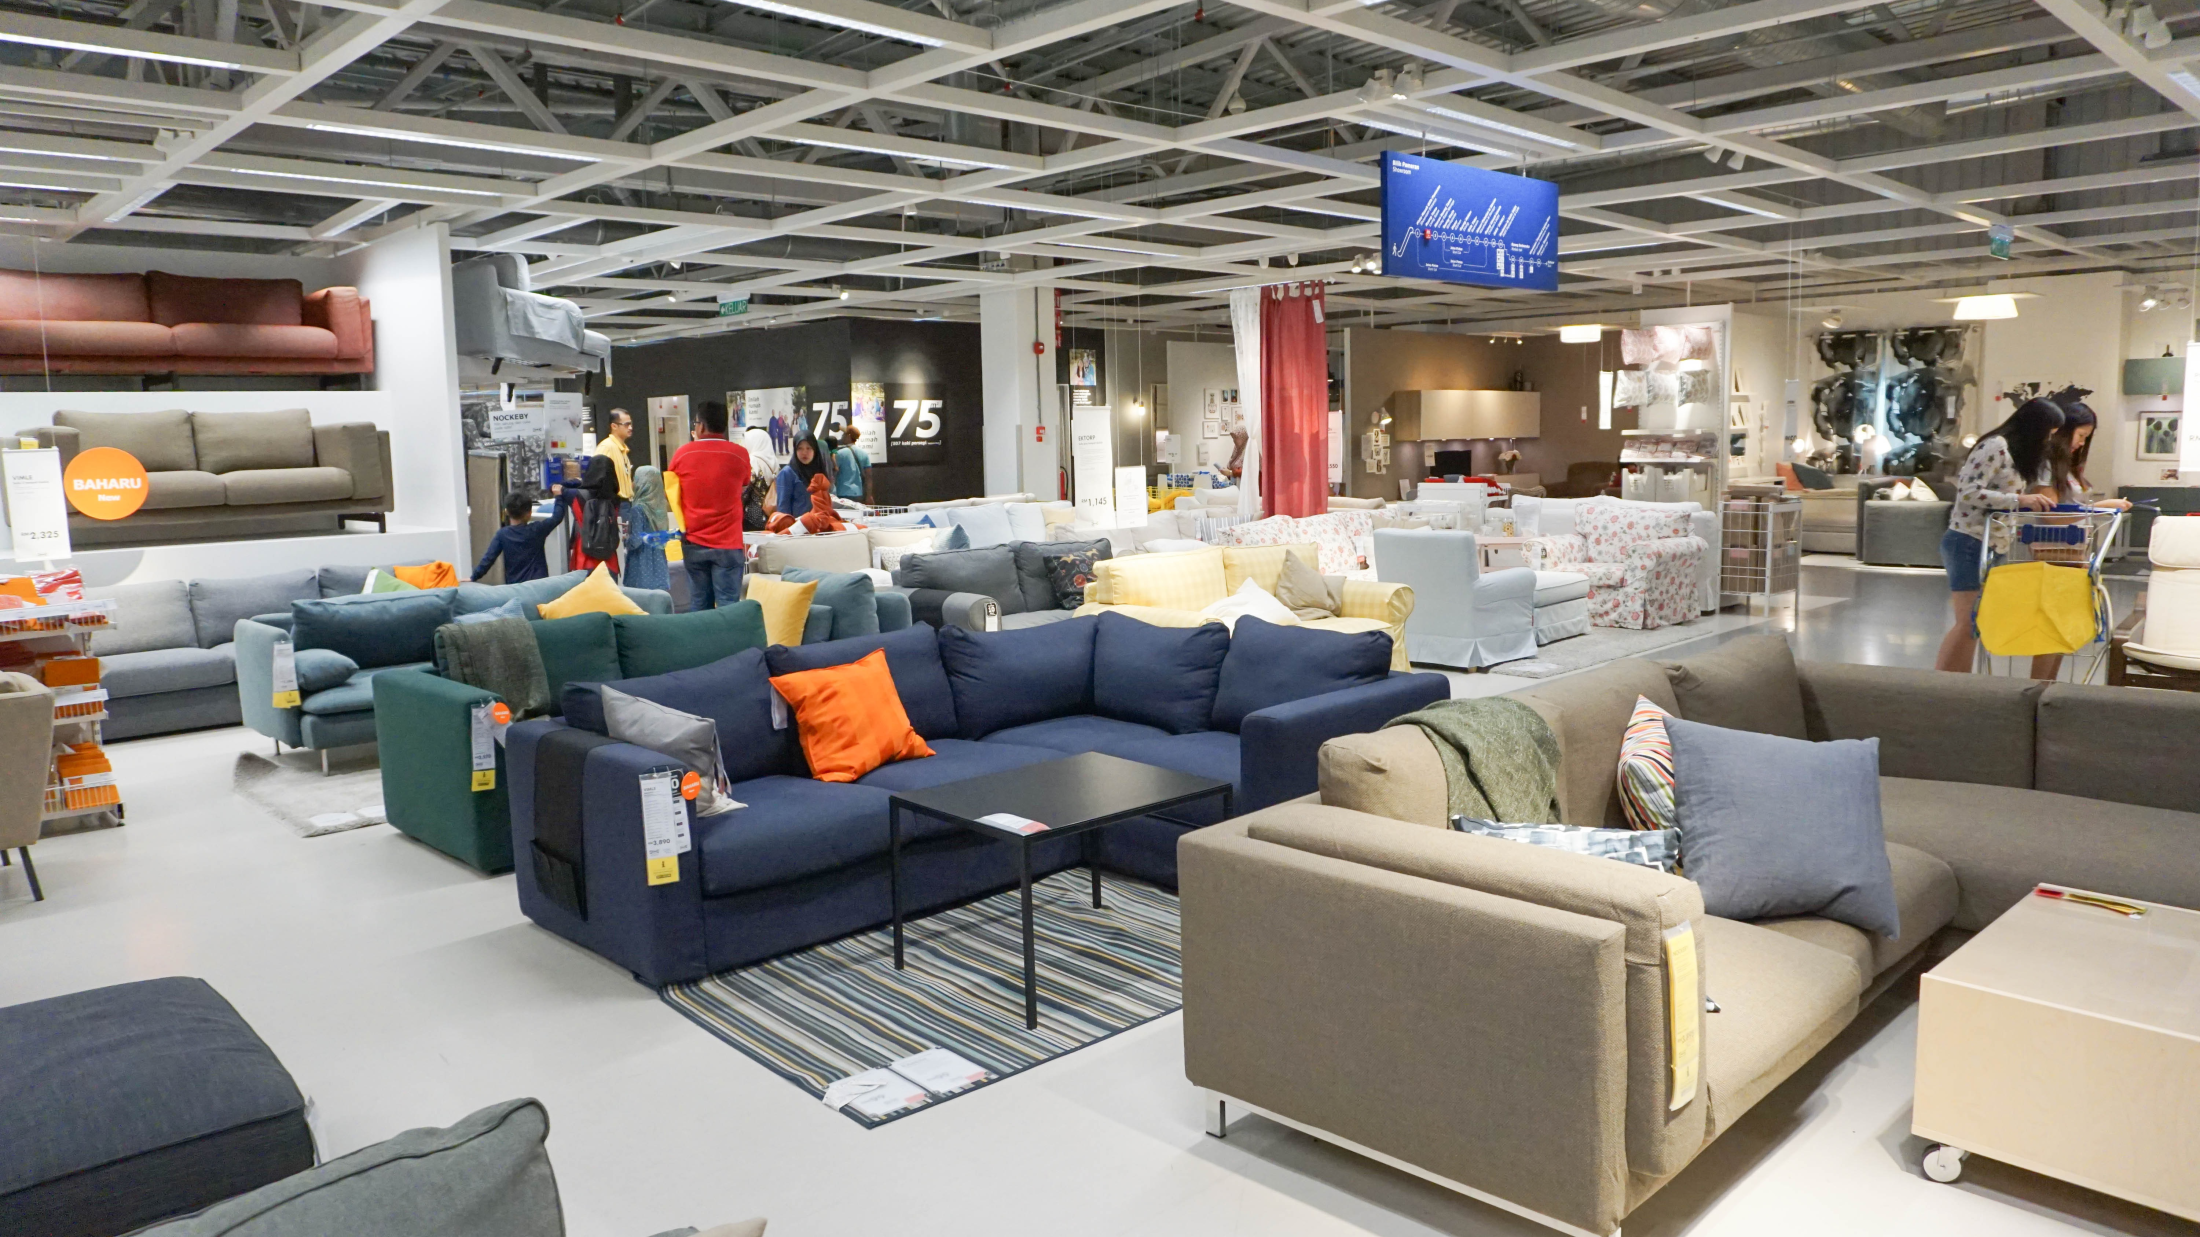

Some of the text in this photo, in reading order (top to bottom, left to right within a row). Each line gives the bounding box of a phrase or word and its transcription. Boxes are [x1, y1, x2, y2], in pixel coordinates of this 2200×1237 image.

[725, 300, 747, 315] KELUAR
[493, 413, 529, 422] NOCKEBY
[811, 401, 848, 440] 75
[890, 399, 943, 438] 75
[73, 477, 142, 491] BAHARU
[98, 494, 121, 502] New
[1088, 497, 1107, 507] 1,145
[31, 530, 59, 540] 2,325
[653, 838, 671, 846] 3,890
